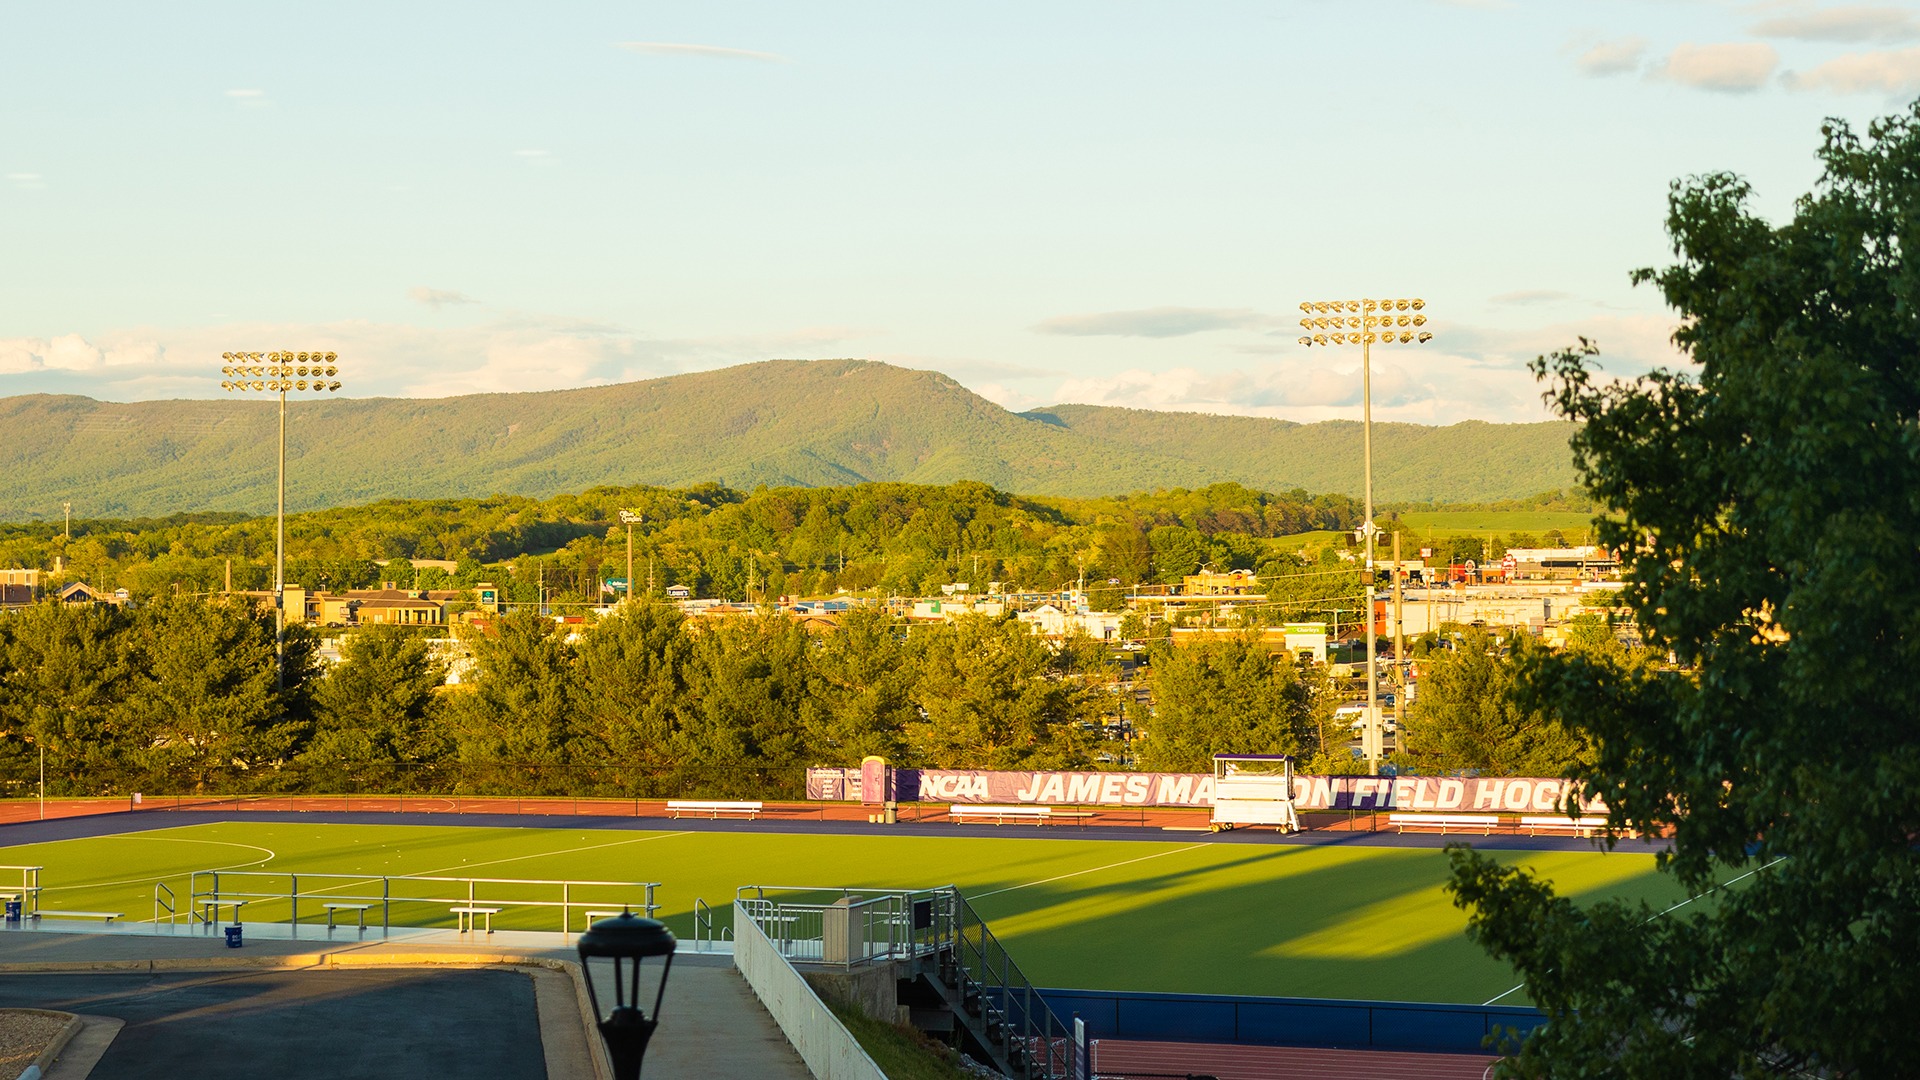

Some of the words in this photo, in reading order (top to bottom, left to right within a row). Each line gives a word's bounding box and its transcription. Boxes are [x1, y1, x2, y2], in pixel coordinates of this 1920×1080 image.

[918, 775, 989, 798] NCAA
[1017, 774, 1149, 803] JAMES
[1156, 775, 1341, 807] MAON
[1352, 778, 1465, 809] FIELD
[1473, 779, 1612, 811] HOCK
